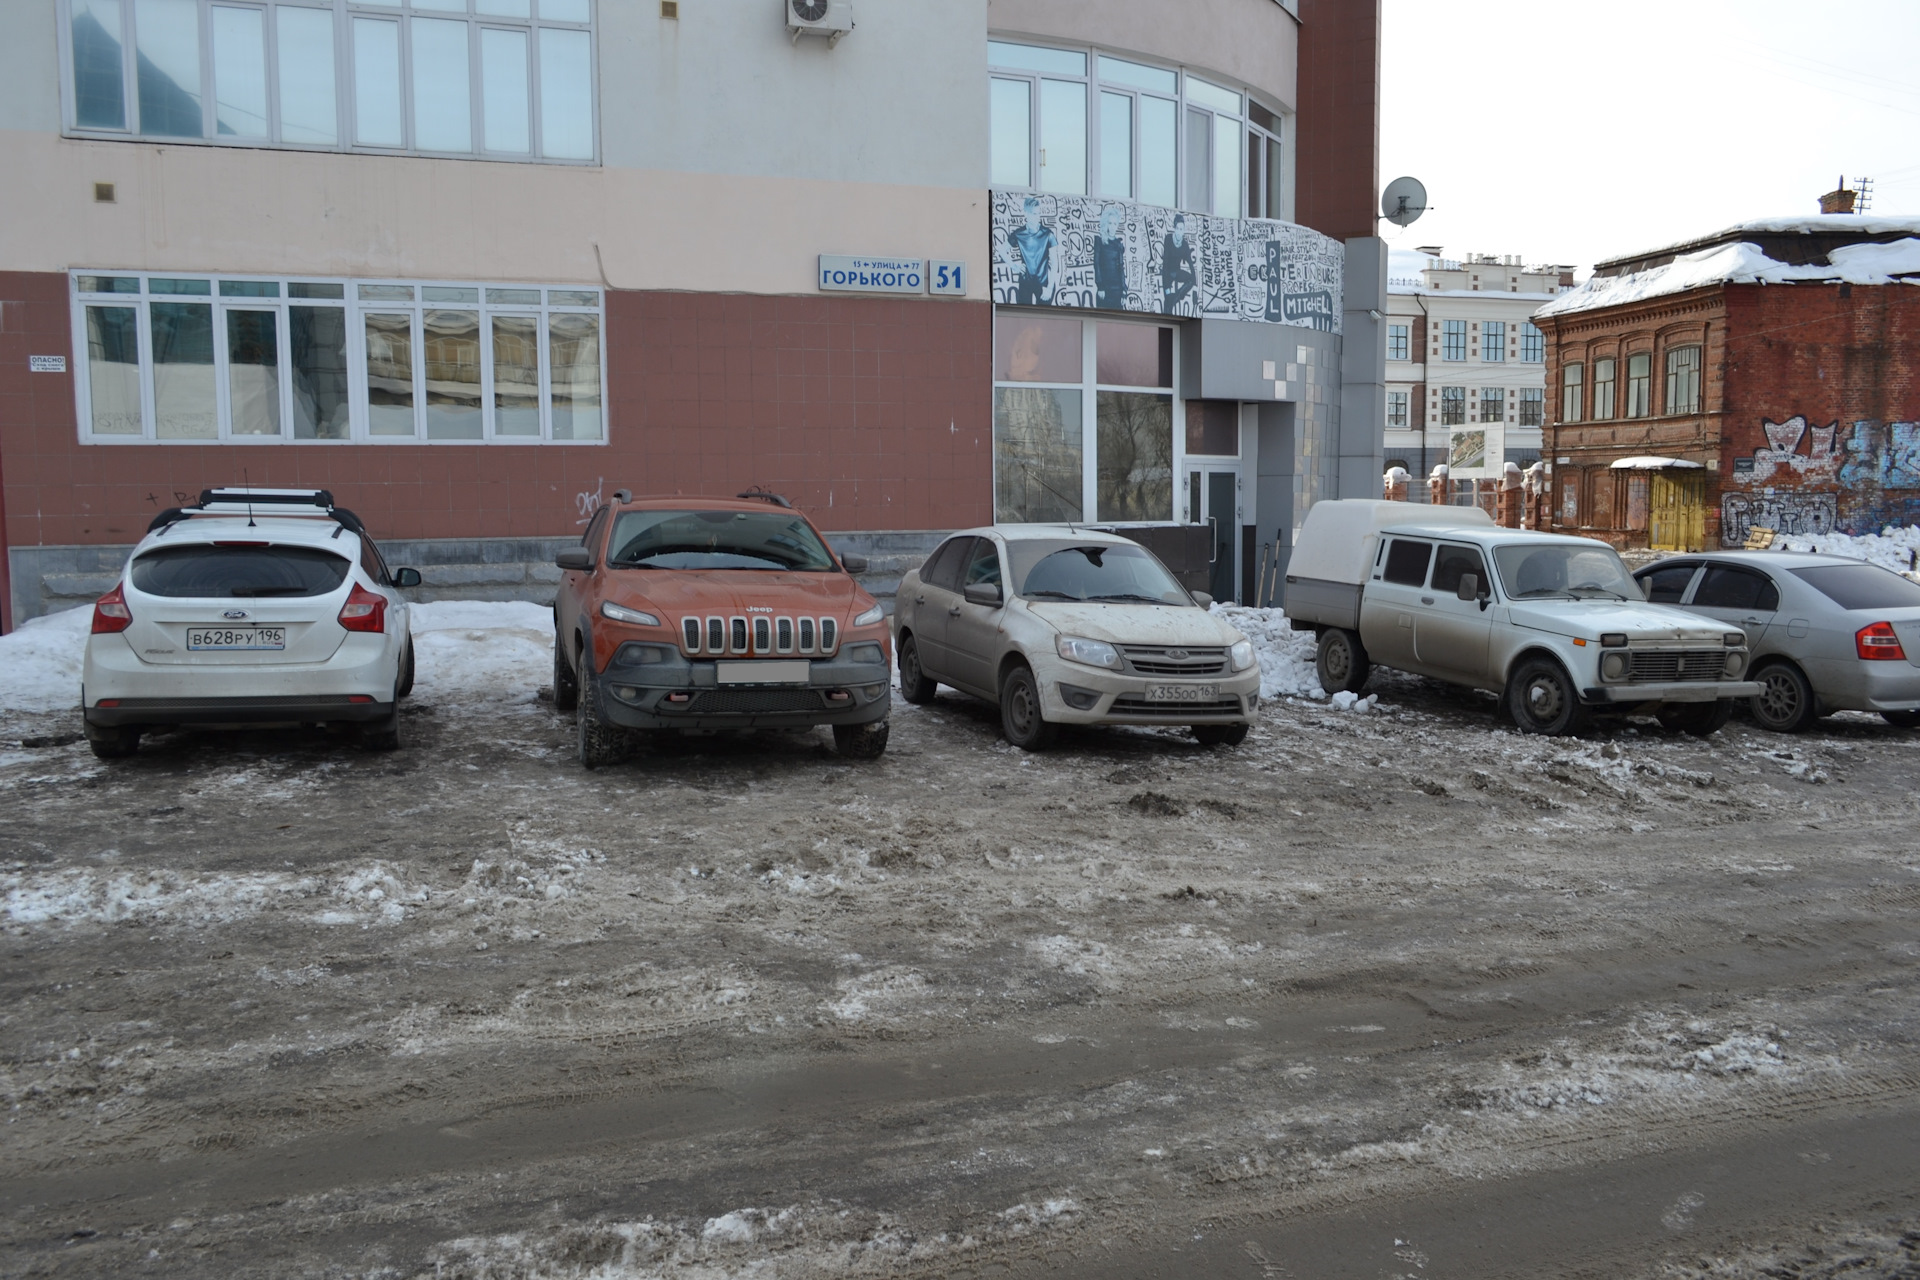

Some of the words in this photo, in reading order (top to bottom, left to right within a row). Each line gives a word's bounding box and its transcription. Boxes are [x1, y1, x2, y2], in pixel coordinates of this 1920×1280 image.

[872, 262, 902, 270] УЛИЦА
[823, 270, 920, 287] ГОРЬКОГО
[936, 266, 961, 288] 51
[1269, 247, 1279, 313] PAUL
[1287, 295, 1331, 314] MITCHELL
